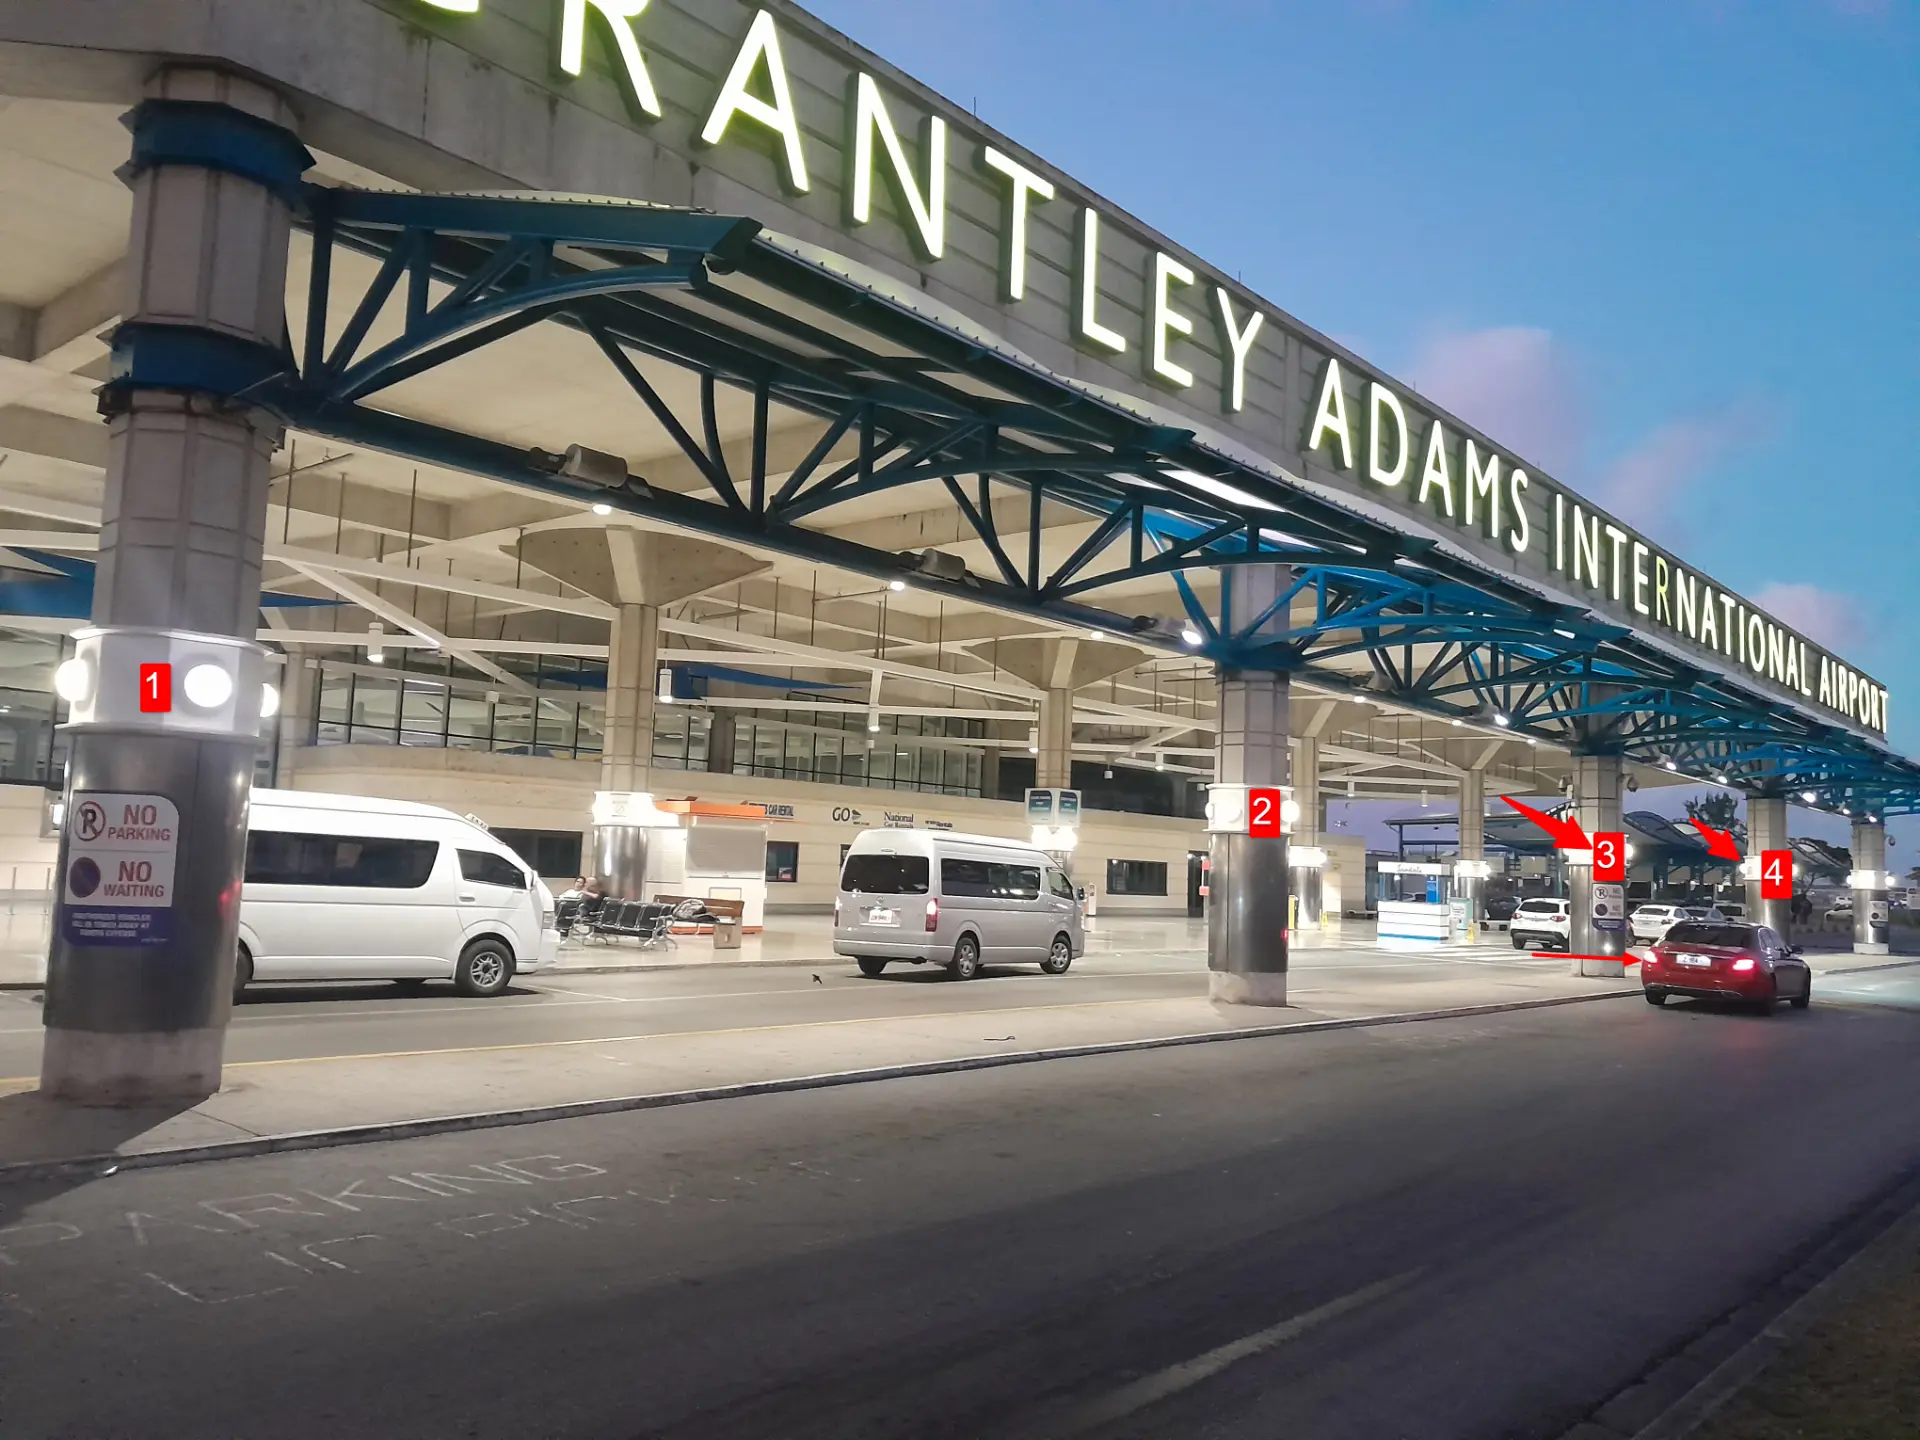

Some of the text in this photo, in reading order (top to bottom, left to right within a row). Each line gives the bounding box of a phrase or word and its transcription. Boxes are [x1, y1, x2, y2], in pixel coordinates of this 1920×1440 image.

[421, 0, 1888, 734] RANTLEY ADAMS INTERNATIONAL AIRPORT
[123, 804, 157, 826] NO
[832, 807, 850, 821] GO
[884, 811, 914, 822] National
[107, 826, 171, 842] PARKING
[118, 861, 152, 883] NO
[103, 884, 164, 898] WAITING
[0, 1153, 607, 1267] PARKING
